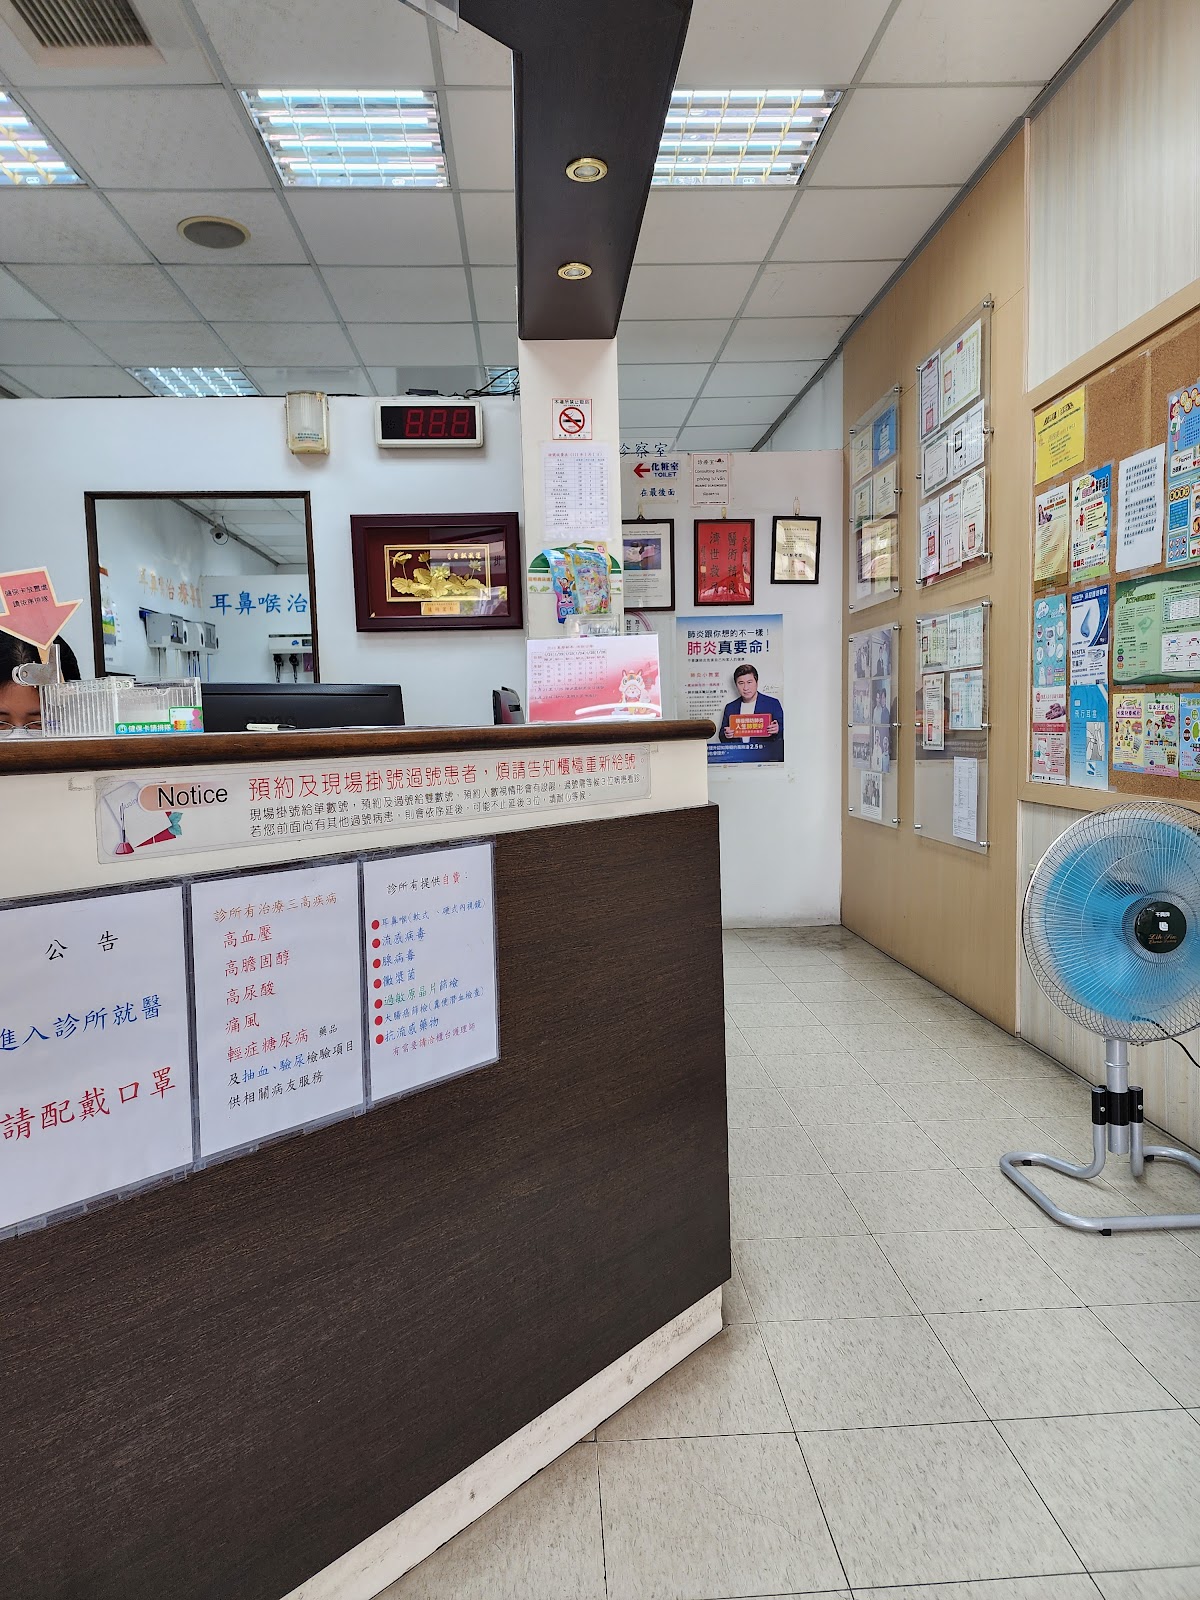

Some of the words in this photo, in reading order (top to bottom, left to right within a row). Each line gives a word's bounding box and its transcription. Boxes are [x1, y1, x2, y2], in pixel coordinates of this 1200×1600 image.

[640, 487, 676, 498] 在最後面
[727, 531, 738, 595] 醫術精良
[209, 590, 309, 616] 耳鼻喉治
[687, 628, 769, 639] 肺炎跟你想的不一樣！
[687, 639, 769, 656] 肺炎真要命！
[1074, 709, 1097, 719] 飛行耳塞
[157, 785, 228, 807] Notice
[214, 892, 338, 923] 診所有治療三高疾病
[223, 924, 273, 949] 高血壓
[381, 926, 426, 947] 流感病毒
[225, 950, 291, 977] 高膽固醇
[381, 949, 416, 968] 腺病毒
[226, 980, 276, 1006] 高尿酸
[384, 977, 459, 1007] 過敏原晶片篩檢
[0, 994, 163, 1051] 進入診所就醫
[225, 1012, 260, 1036] 痛風
[384, 1017, 440, 1043] 抗流感藥物
[226, 1028, 309, 1063] 輕症糖尿病
[318, 1024, 339, 1038] 藥品
[227, 1040, 354, 1087] 及抽血、驗尿檢驗項目
[227, 1069, 324, 1110] 供相關病友服務
[0, 1066, 176, 1141] 請配戴口罩
